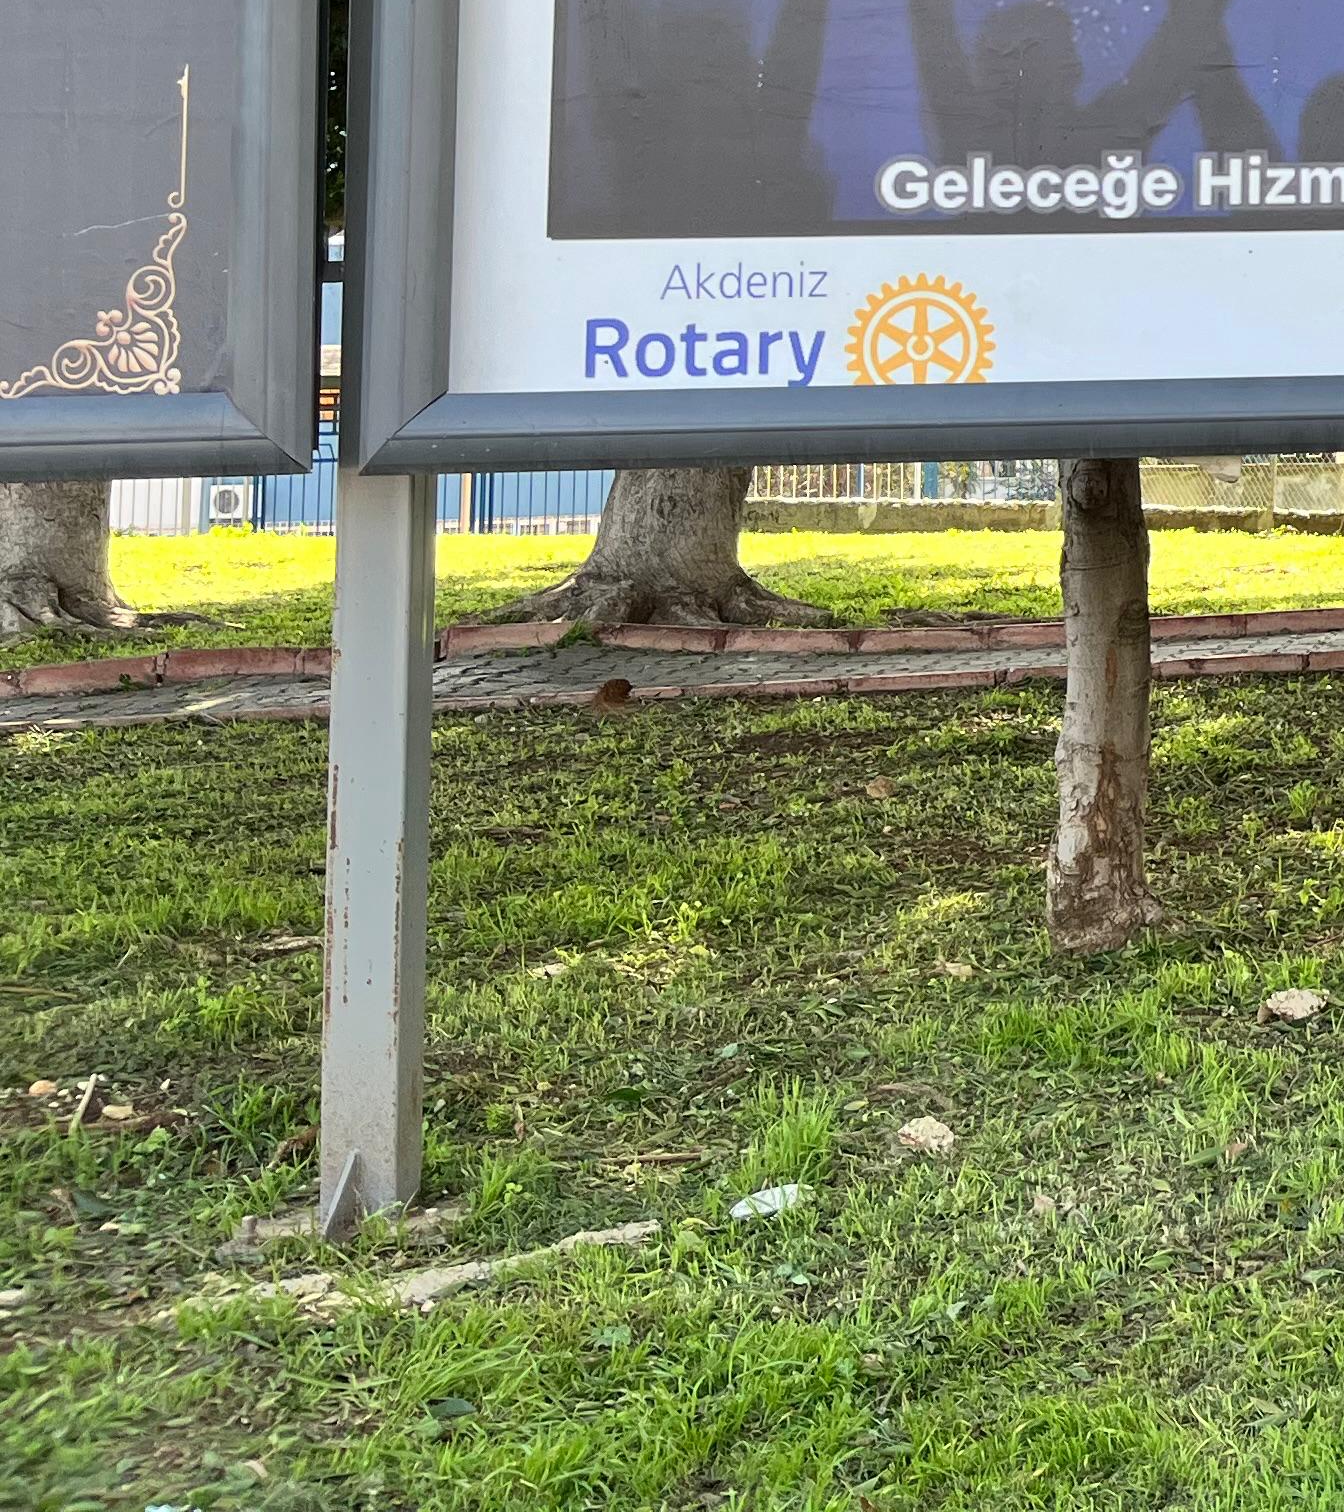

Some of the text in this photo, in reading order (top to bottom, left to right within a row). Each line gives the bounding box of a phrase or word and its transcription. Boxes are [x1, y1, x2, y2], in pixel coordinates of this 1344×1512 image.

[880, 155, 1178, 219] Geleceğe
[659, 261, 828, 300] Akdeniz
[584, 318, 826, 388] Rotary
